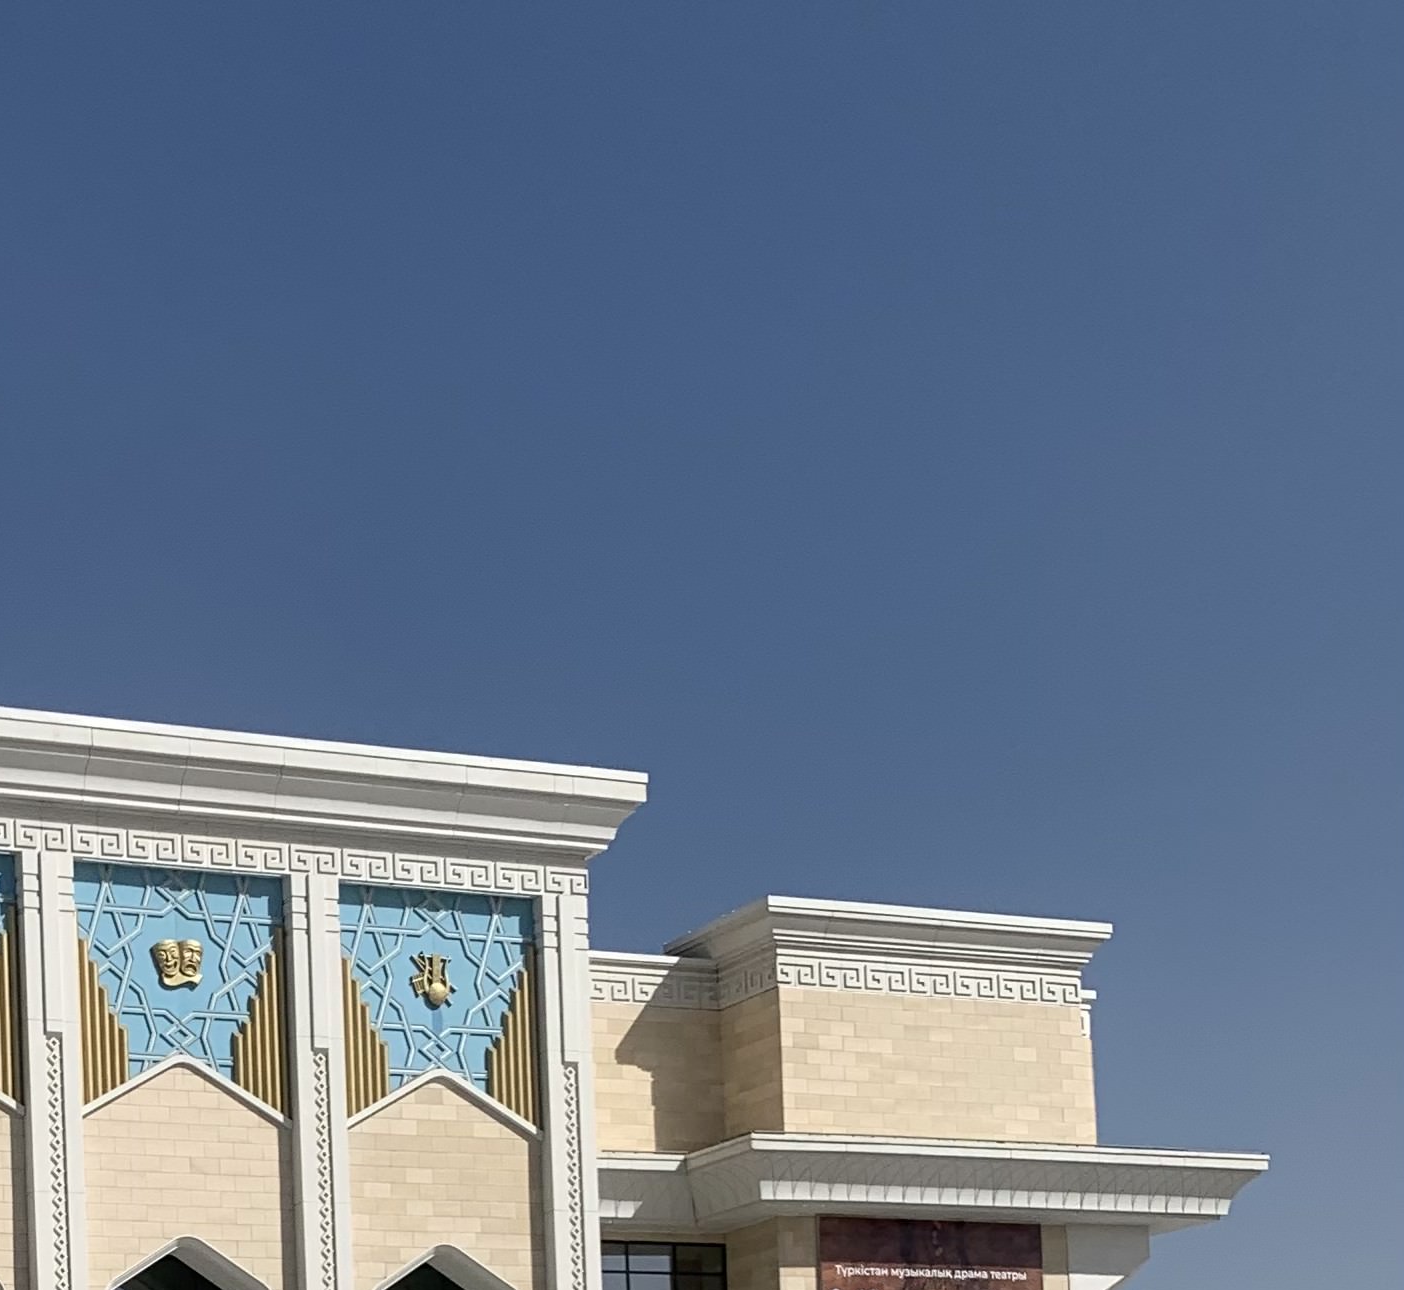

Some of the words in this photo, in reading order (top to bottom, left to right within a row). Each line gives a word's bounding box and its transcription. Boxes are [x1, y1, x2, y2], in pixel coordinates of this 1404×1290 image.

[890, 1267, 953, 1279] музыкалық
[954, 1269, 988, 1280] драма
[990, 1271, 1027, 1282] театры
